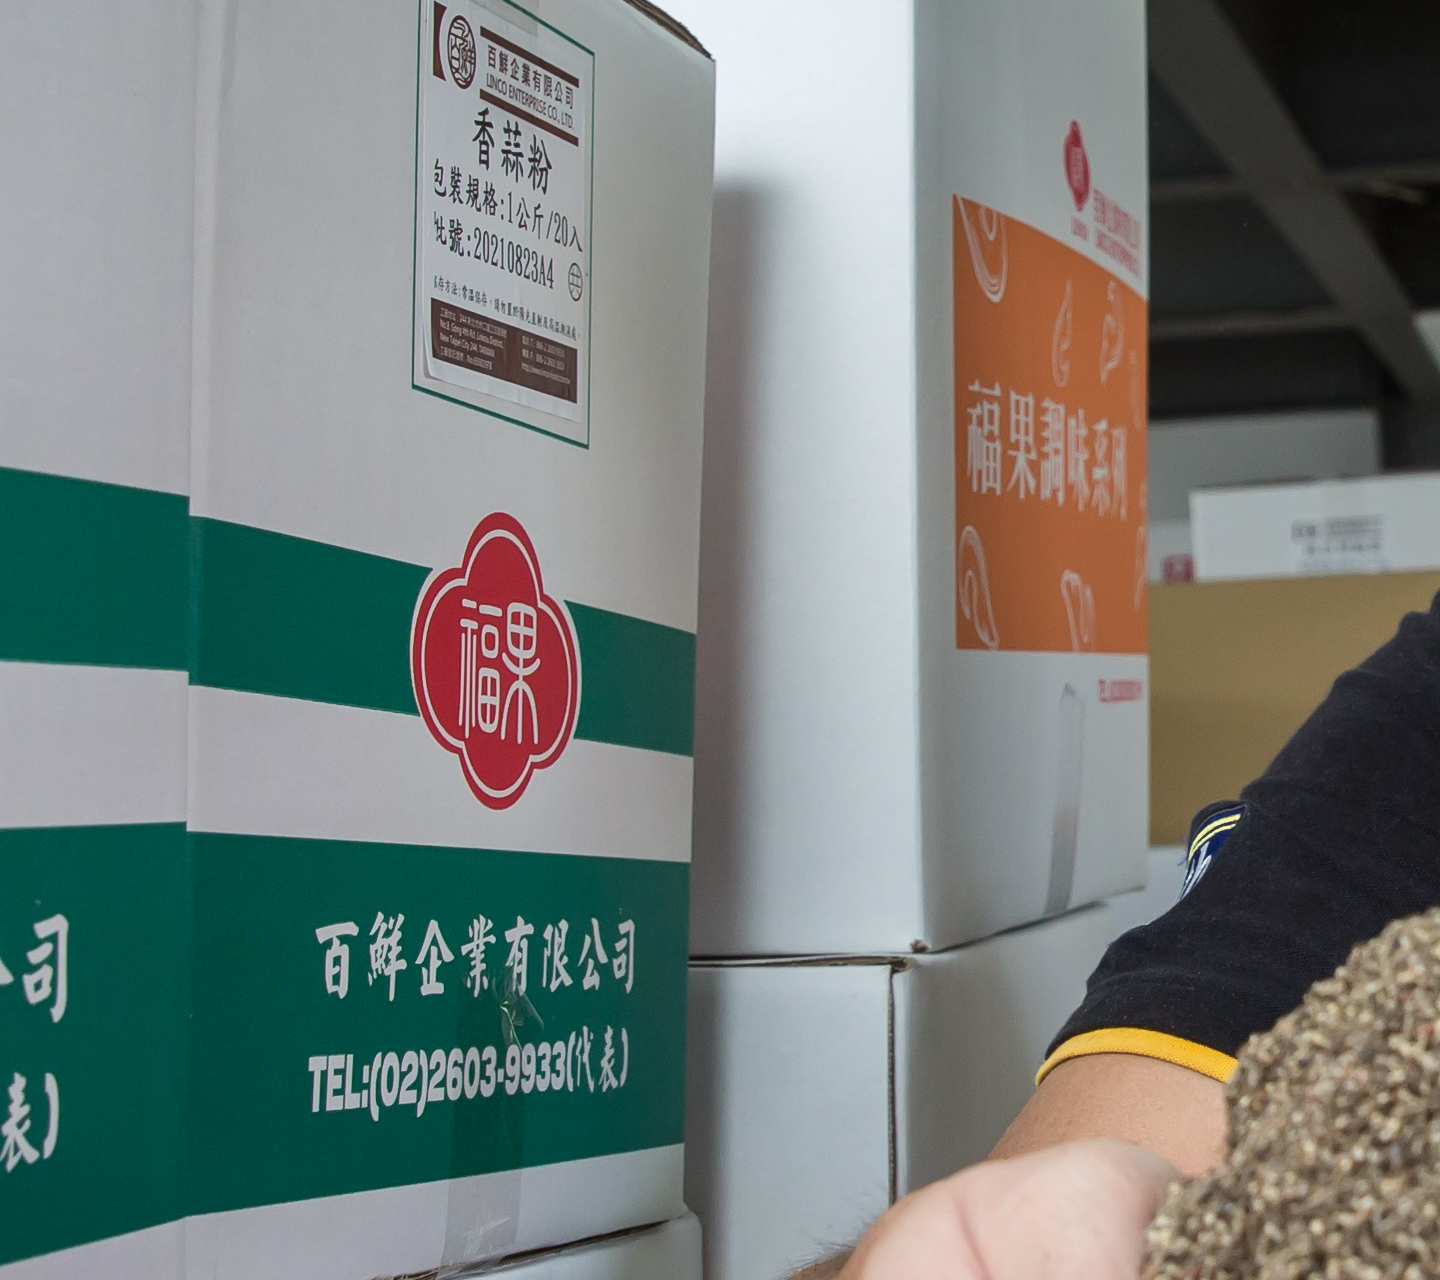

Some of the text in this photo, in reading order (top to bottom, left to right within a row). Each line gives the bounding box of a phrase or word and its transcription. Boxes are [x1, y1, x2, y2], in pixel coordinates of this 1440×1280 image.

[486, 72, 508, 96] LINCO
[488, 44, 574, 110] 百鮮企業有限公司
[473, 107, 553, 196] 香蒜粉
[966, 378, 1128, 521] 福果調味系列
[458, 596, 543, 746] 福果
[315, 911, 636, 1002] 百鮮企業有限公司
